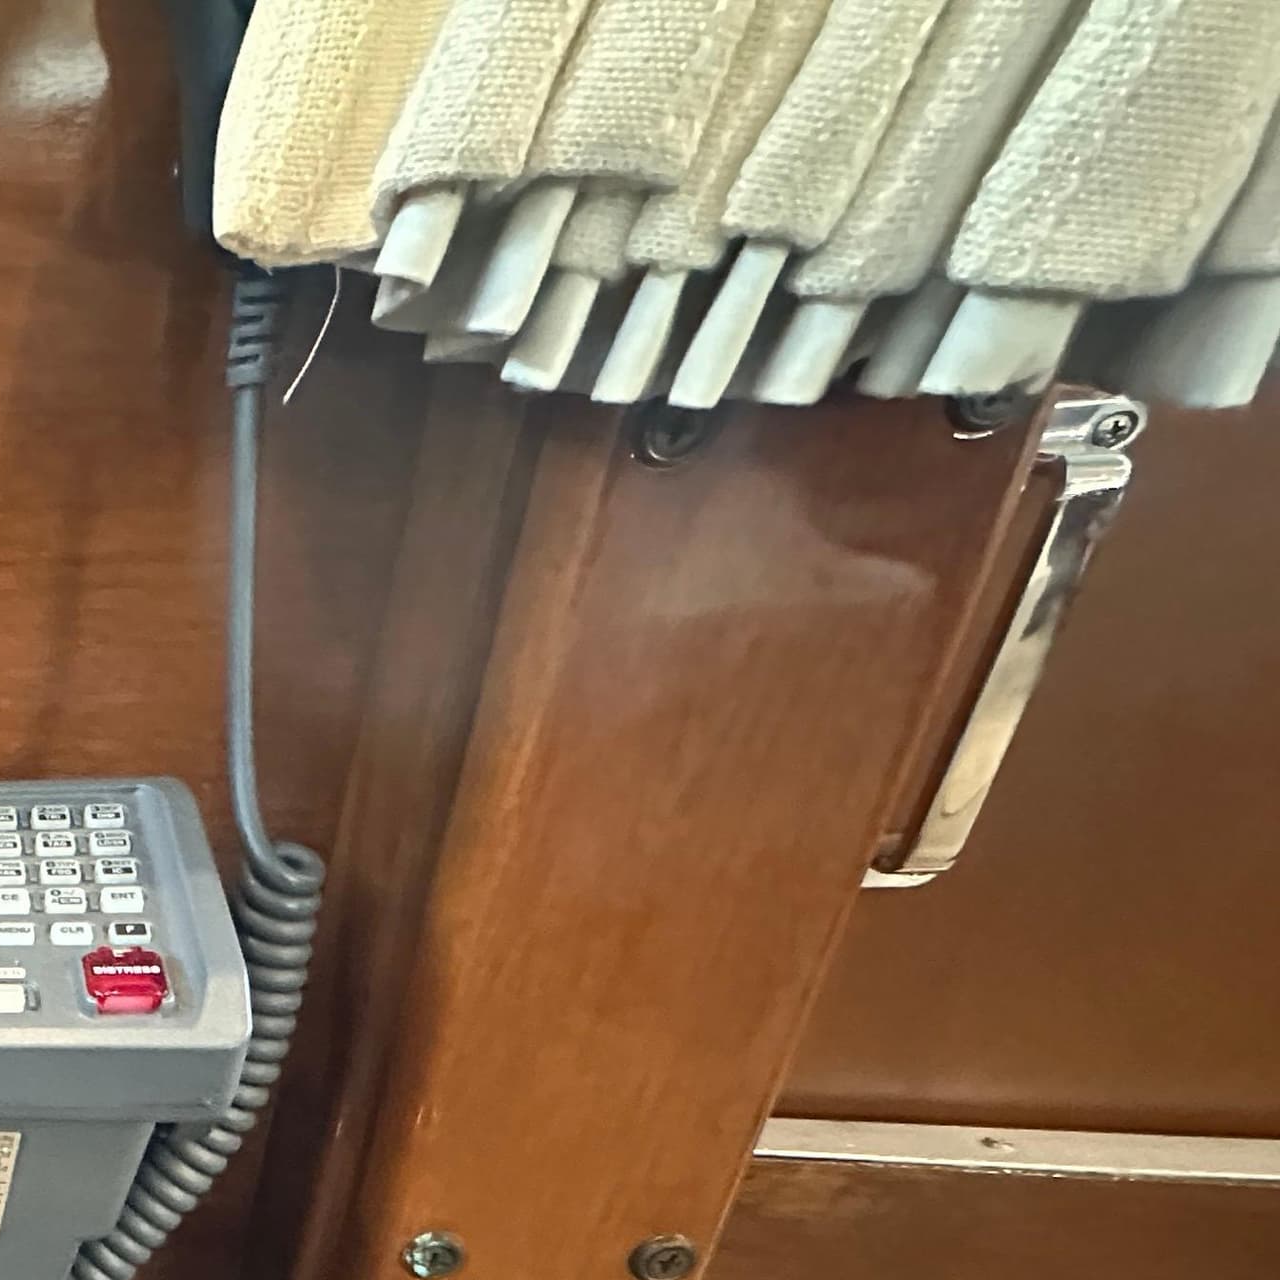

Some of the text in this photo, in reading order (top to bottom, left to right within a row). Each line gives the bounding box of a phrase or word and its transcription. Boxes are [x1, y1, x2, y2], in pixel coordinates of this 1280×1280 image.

[111, 891, 135, 900] ENT
[60, 926, 85, 934] CLR
[92, 965, 161, 975] DISTRESS
